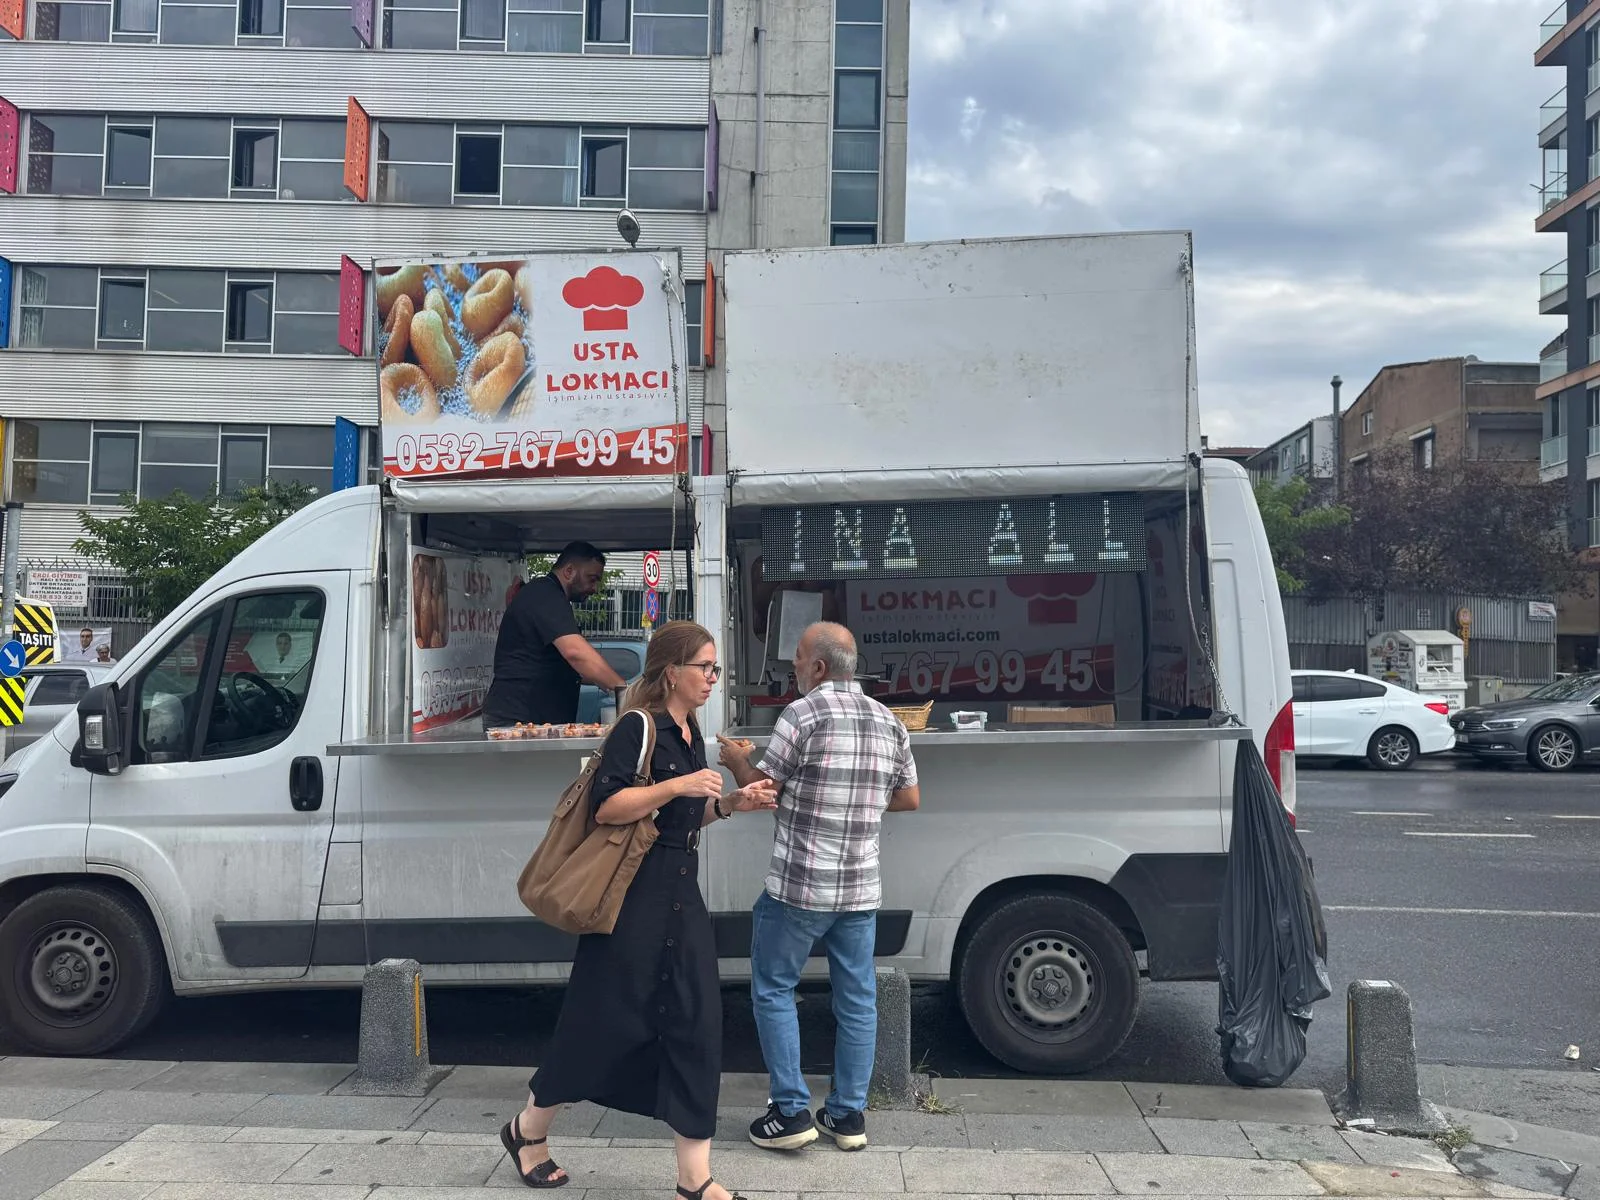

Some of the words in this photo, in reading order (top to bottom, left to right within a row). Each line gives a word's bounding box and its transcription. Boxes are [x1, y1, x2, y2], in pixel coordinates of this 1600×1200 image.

[573, 341, 639, 361] USTA
[546, 370, 669, 392] LOKMACI
[395, 432, 485, 471] 0532
[495, 430, 562, 469] 767
[575, 428, 619, 467] 99
[630, 427, 675, 465] 45
[762, 508, 918, 573] INA
[988, 500, 1129, 565] ALL
[646, 562, 658, 578] 30
[860, 588, 997, 612] LOKMACI
[450, 608, 505, 633] LOKMAC
[19, 632, 52, 648] TAŞITI
[863, 627, 1000, 644] ustalokmaci.com
[881, 651, 959, 695] 767
[973, 649, 1026, 694] 99
[1041, 647, 1090, 692] 45
